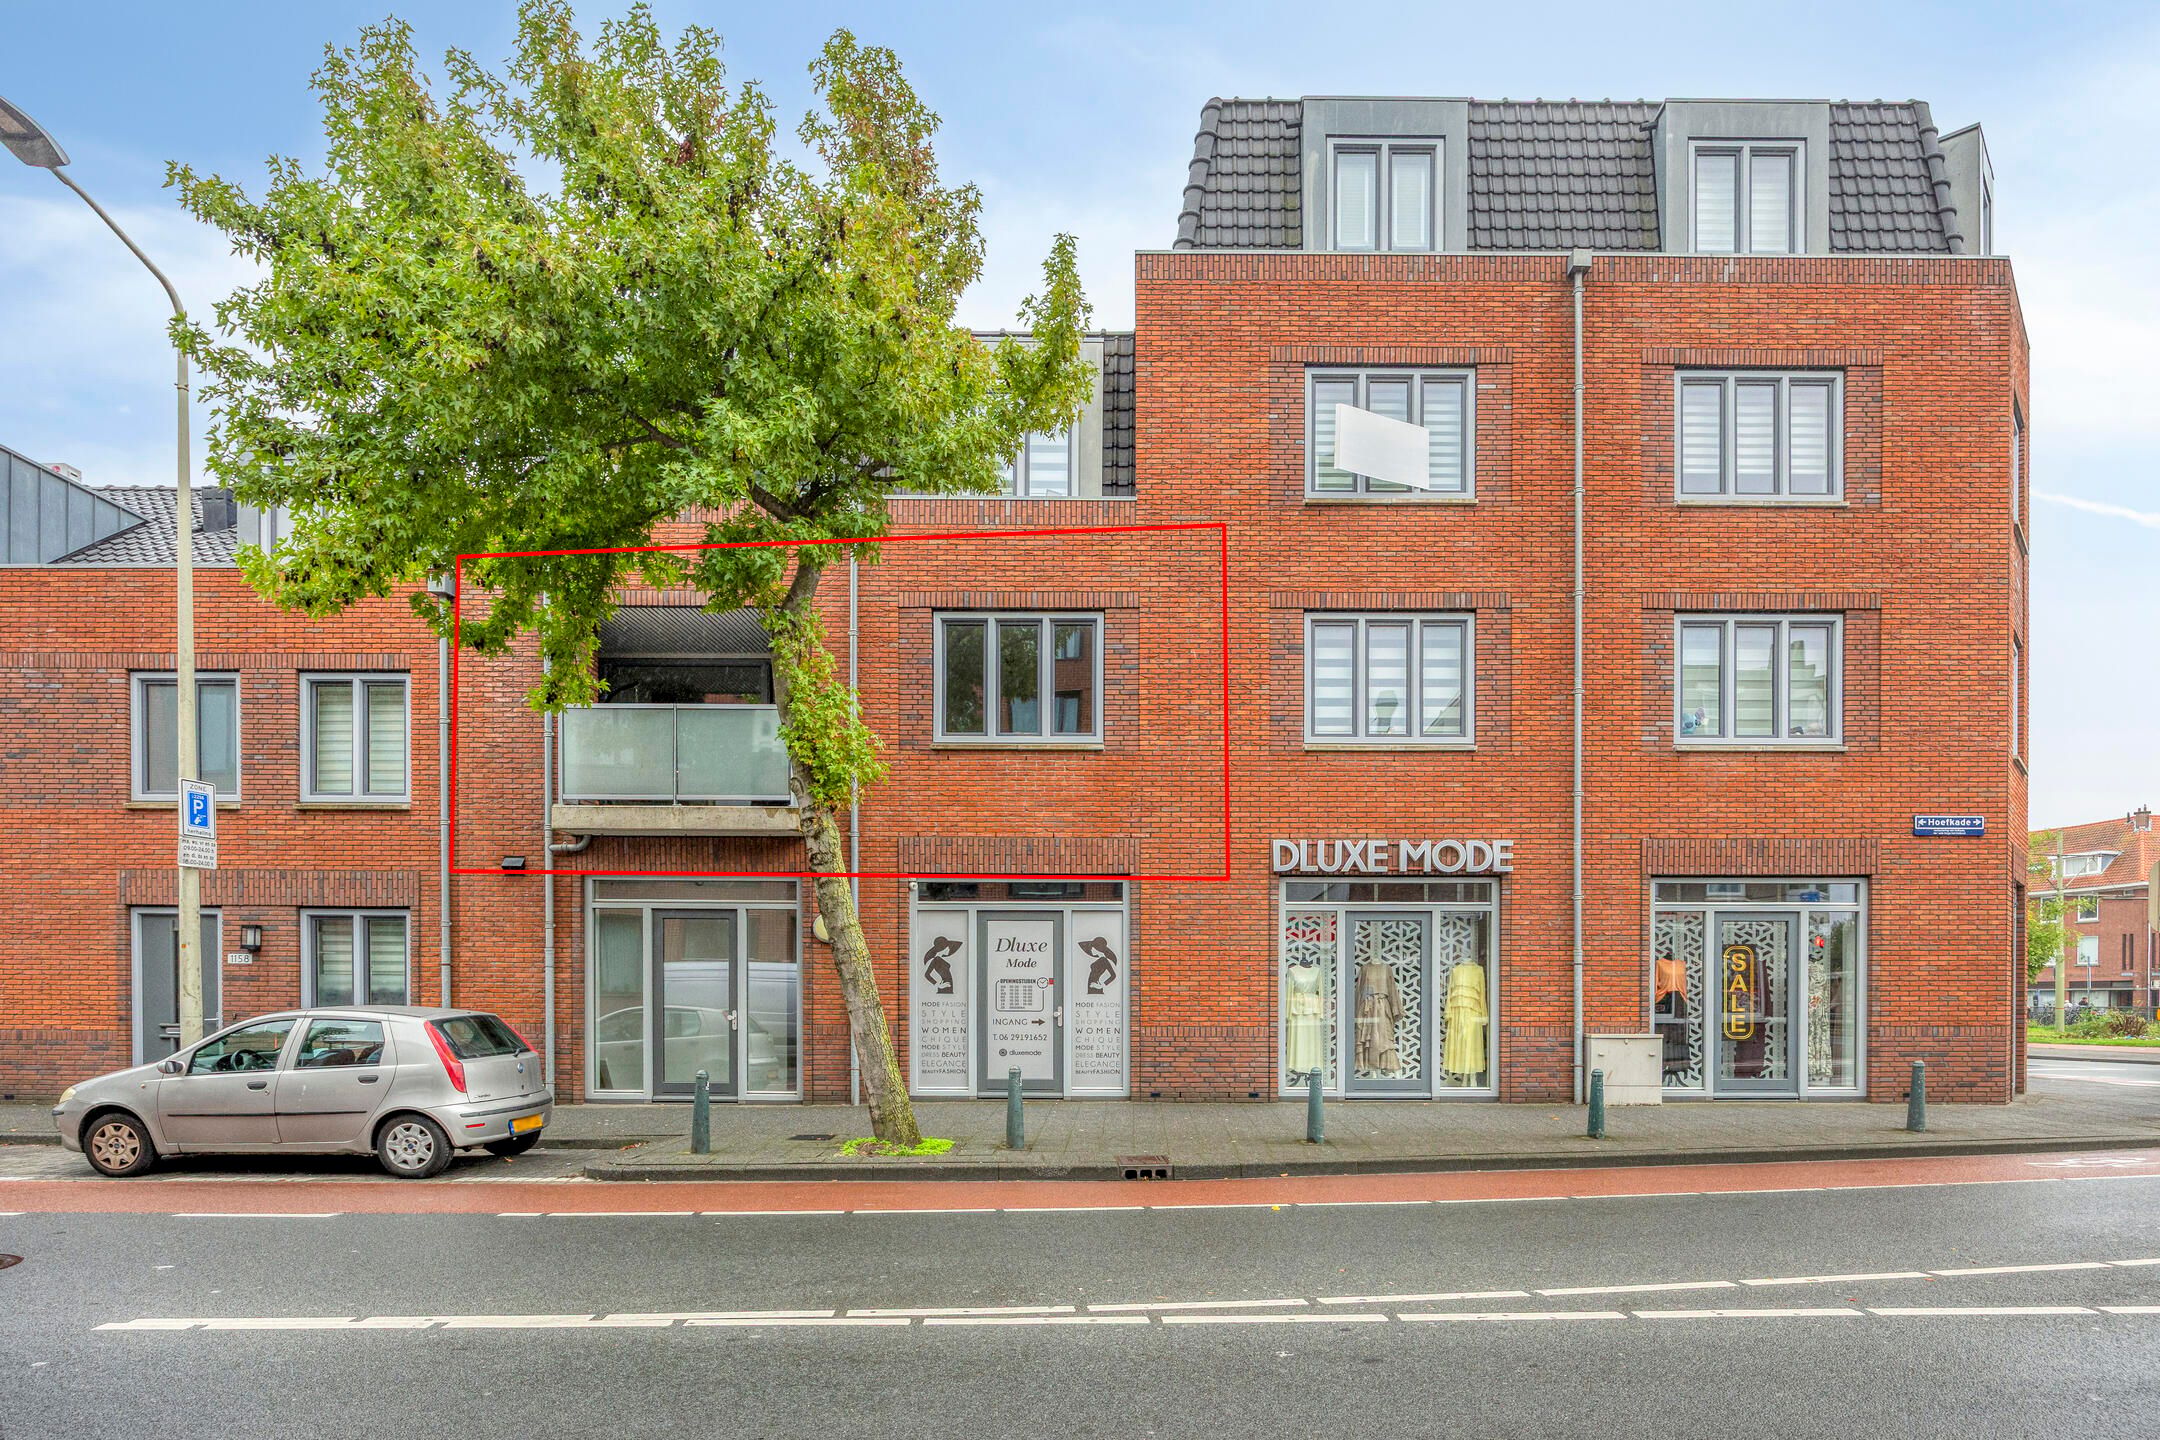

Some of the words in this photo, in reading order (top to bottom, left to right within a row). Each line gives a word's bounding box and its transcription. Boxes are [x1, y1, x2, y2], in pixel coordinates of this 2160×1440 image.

[189, 784, 207, 792] ZONE
[193, 800, 204, 814] P
[1928, 818, 1971, 826] Hoefkade
[1272, 839, 1388, 873] DLUXE
[1400, 839, 1514, 873] MODE
[995, 936, 1048, 953] Dluxe
[1006, 957, 1037, 969] Mode
[1729, 952, 1748, 1033] SALE
[921, 1009, 966, 1018] STYLE
[1075, 1010, 1121, 1018] STYLE
[992, 1018, 1028, 1026] INGANG
[921, 1026, 967, 1034] WOMEN
[1075, 1027, 1121, 1035] WOMEN
[998, 1033, 1009, 1041] 06
[1010, 1033, 1048, 1041] 29191652
[1075, 1036, 1121, 1044] CHIQUE
[921, 1060, 967, 1068] ELEGANCE
[1075, 1060, 1121, 1068] ELEGANCE
